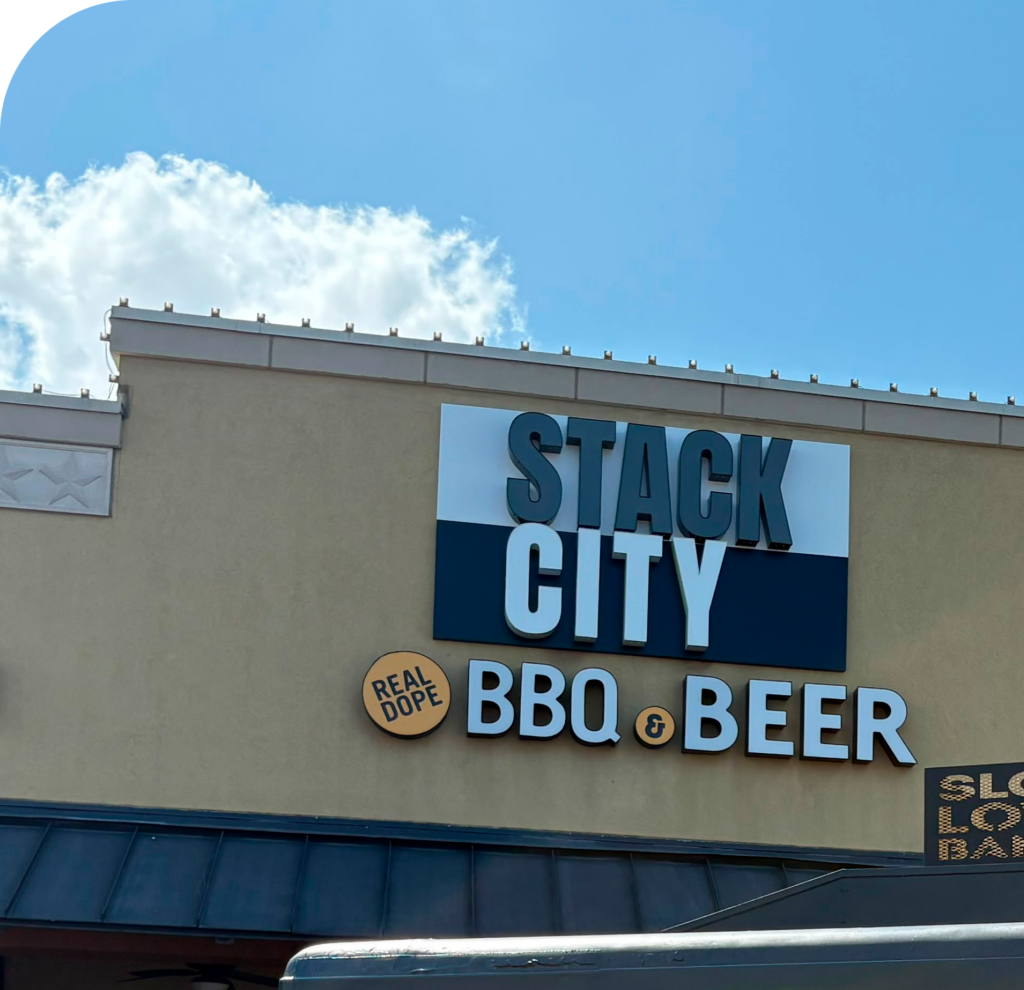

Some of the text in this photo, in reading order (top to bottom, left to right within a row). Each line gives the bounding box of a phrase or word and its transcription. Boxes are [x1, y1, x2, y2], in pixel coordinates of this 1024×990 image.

[506, 411, 794, 551] STACK
[504, 522, 728, 652] CITY
[371, 665, 433, 702] REAL
[380, 684, 444, 723] DOPE
[467, 658, 917, 767] BBQ & BEER
